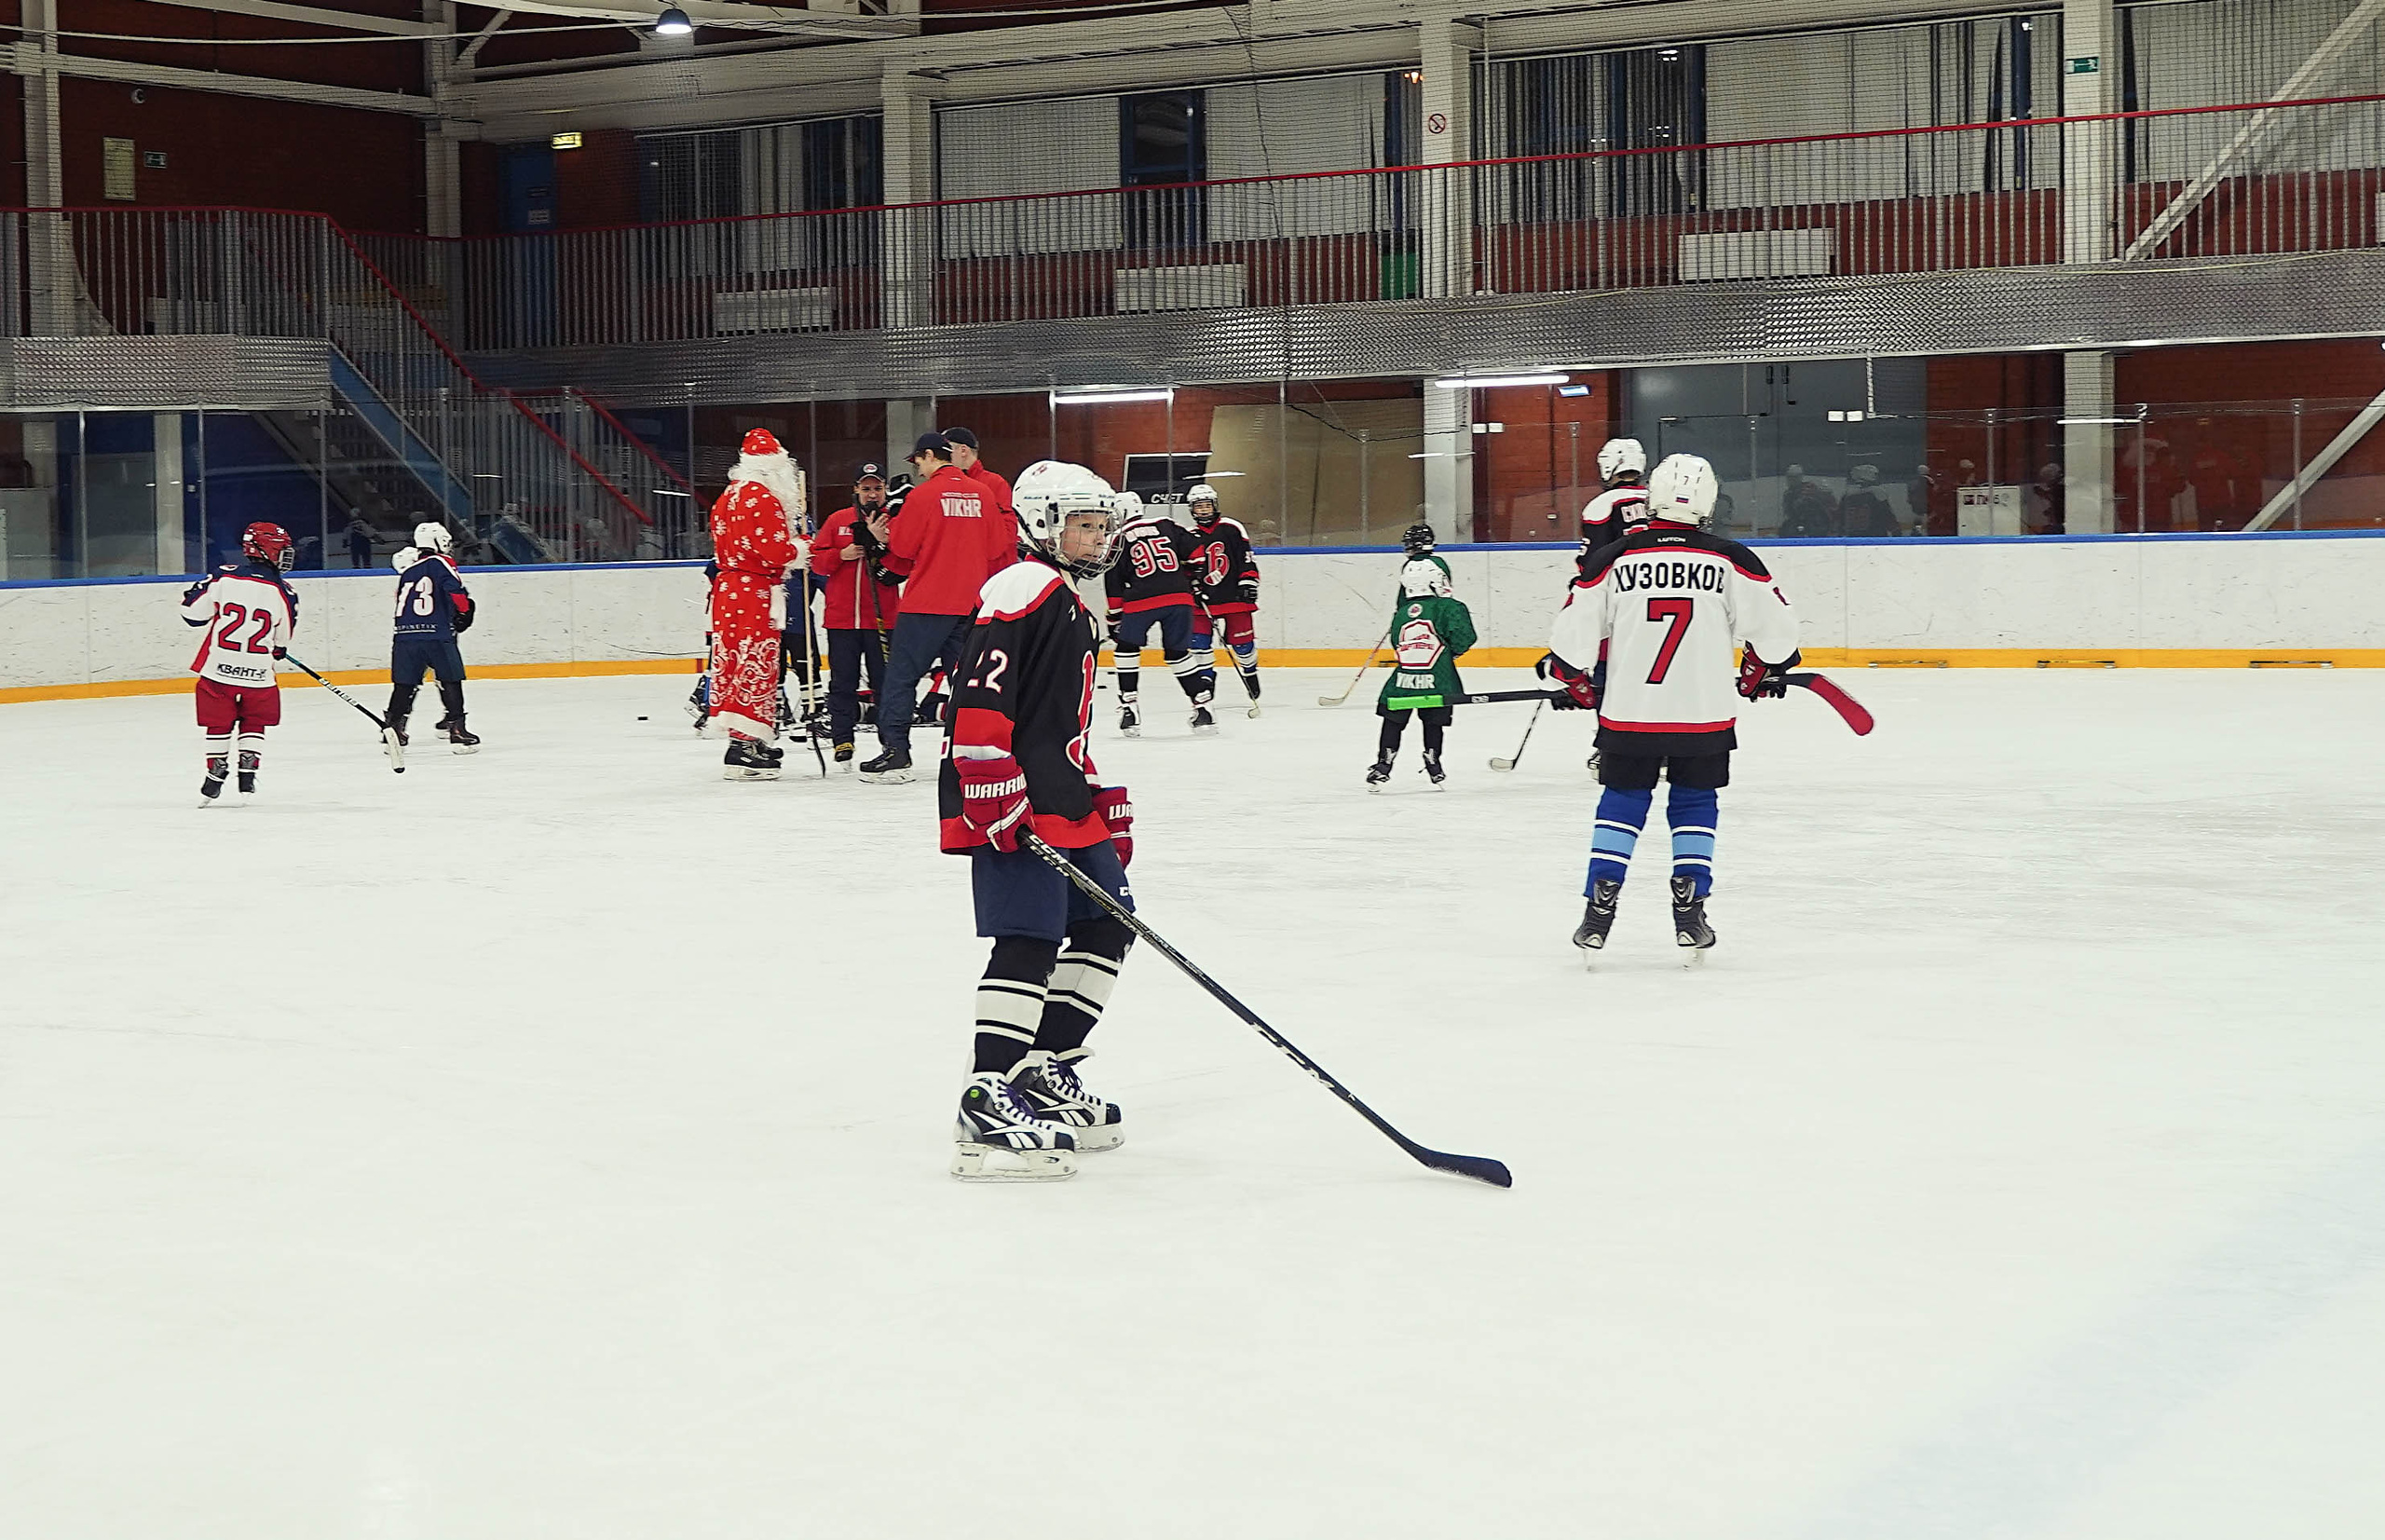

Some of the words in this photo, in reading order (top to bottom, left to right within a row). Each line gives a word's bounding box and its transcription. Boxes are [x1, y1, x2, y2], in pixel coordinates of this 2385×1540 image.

[940, 497, 982, 518] VIKHR
[1130, 536, 1179, 578] 95
[217, 602, 272, 654] 22
[1644, 597, 1694, 684] 7
[1029, 834, 1069, 865] CCM
